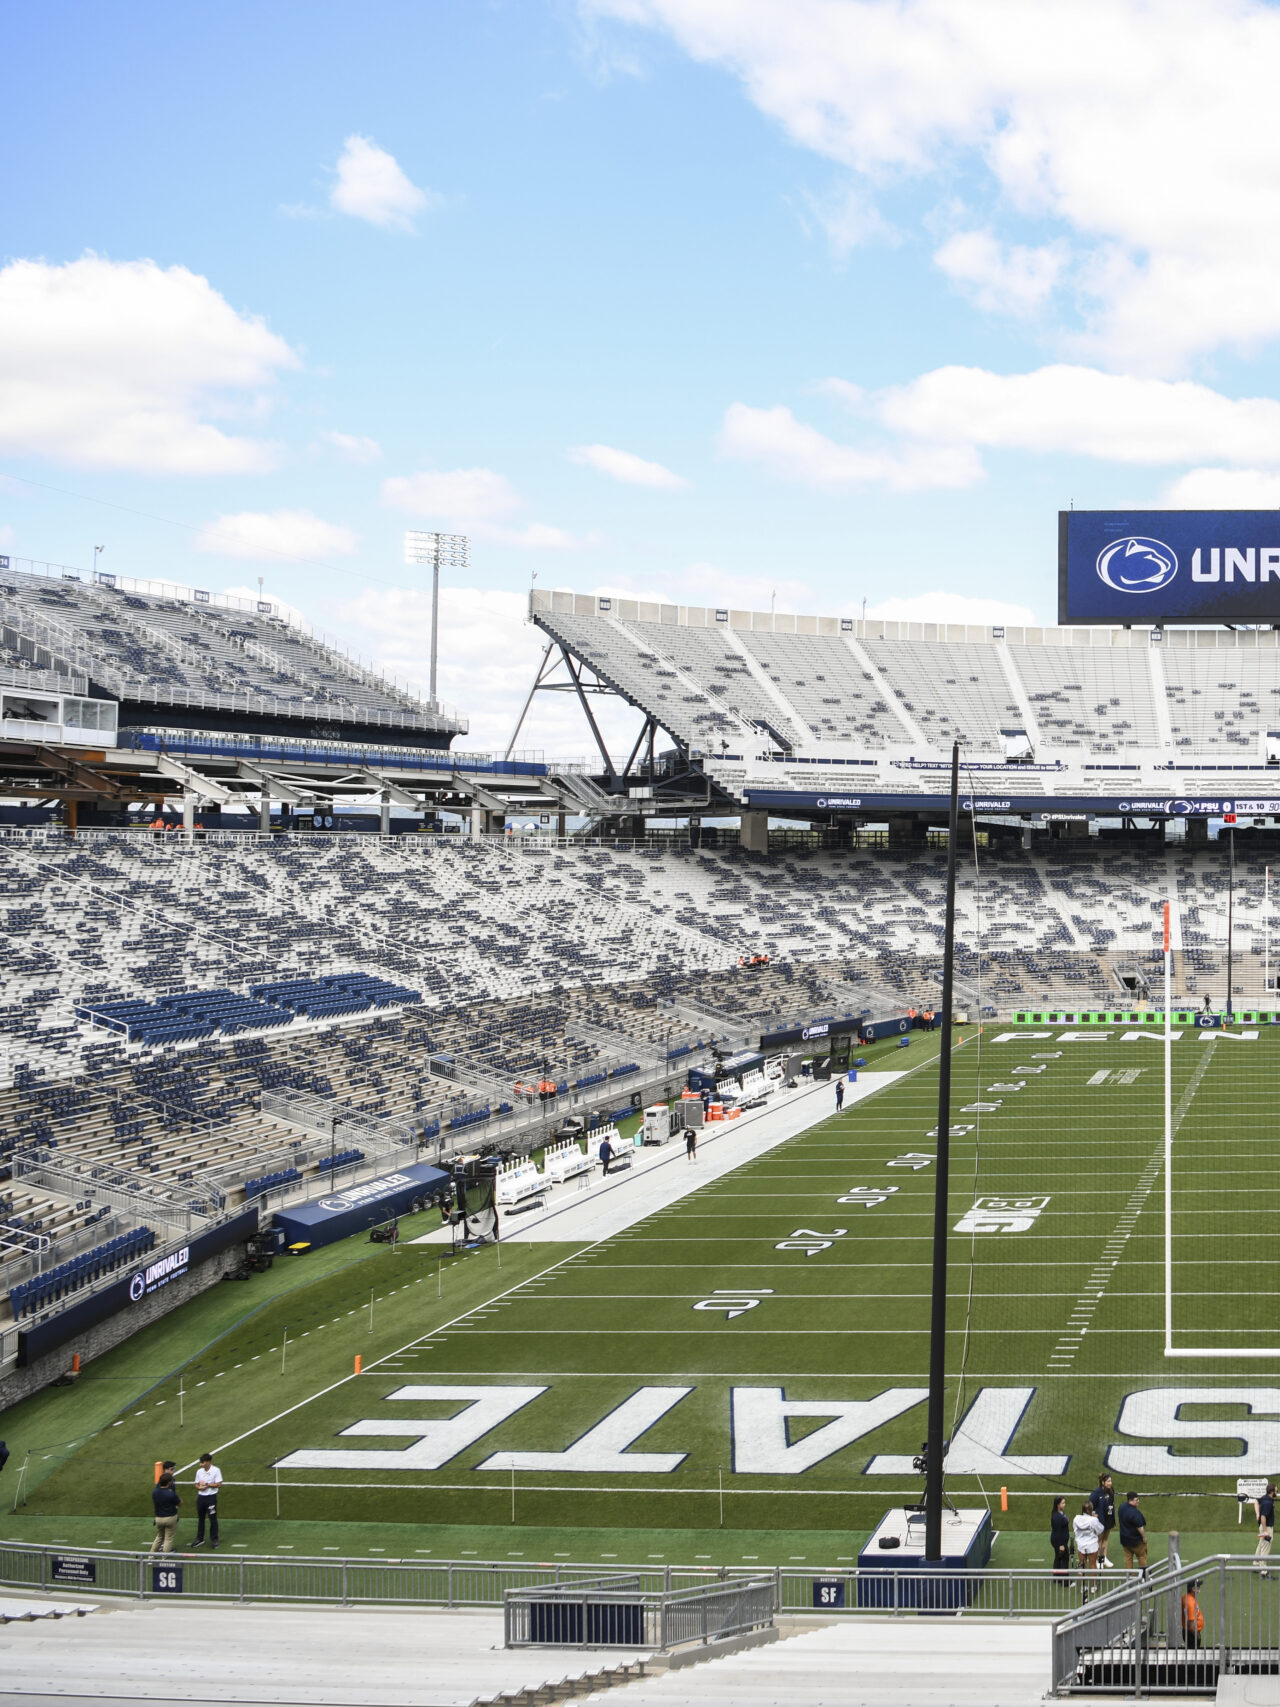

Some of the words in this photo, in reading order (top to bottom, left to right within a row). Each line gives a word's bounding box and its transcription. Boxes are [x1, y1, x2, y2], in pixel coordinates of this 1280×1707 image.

[990, 1031, 1261, 1042] PENN
[336, 1173, 413, 1202] UNRIVALED
[835, 1185, 901, 1204] 30
[774, 1228, 849, 1250] 20
[145, 1246, 190, 1285] UNRIVALED
[691, 1288, 776, 1311] 10
[159, 1572, 176, 1588] SG
[821, 1587, 837, 1603] SF
